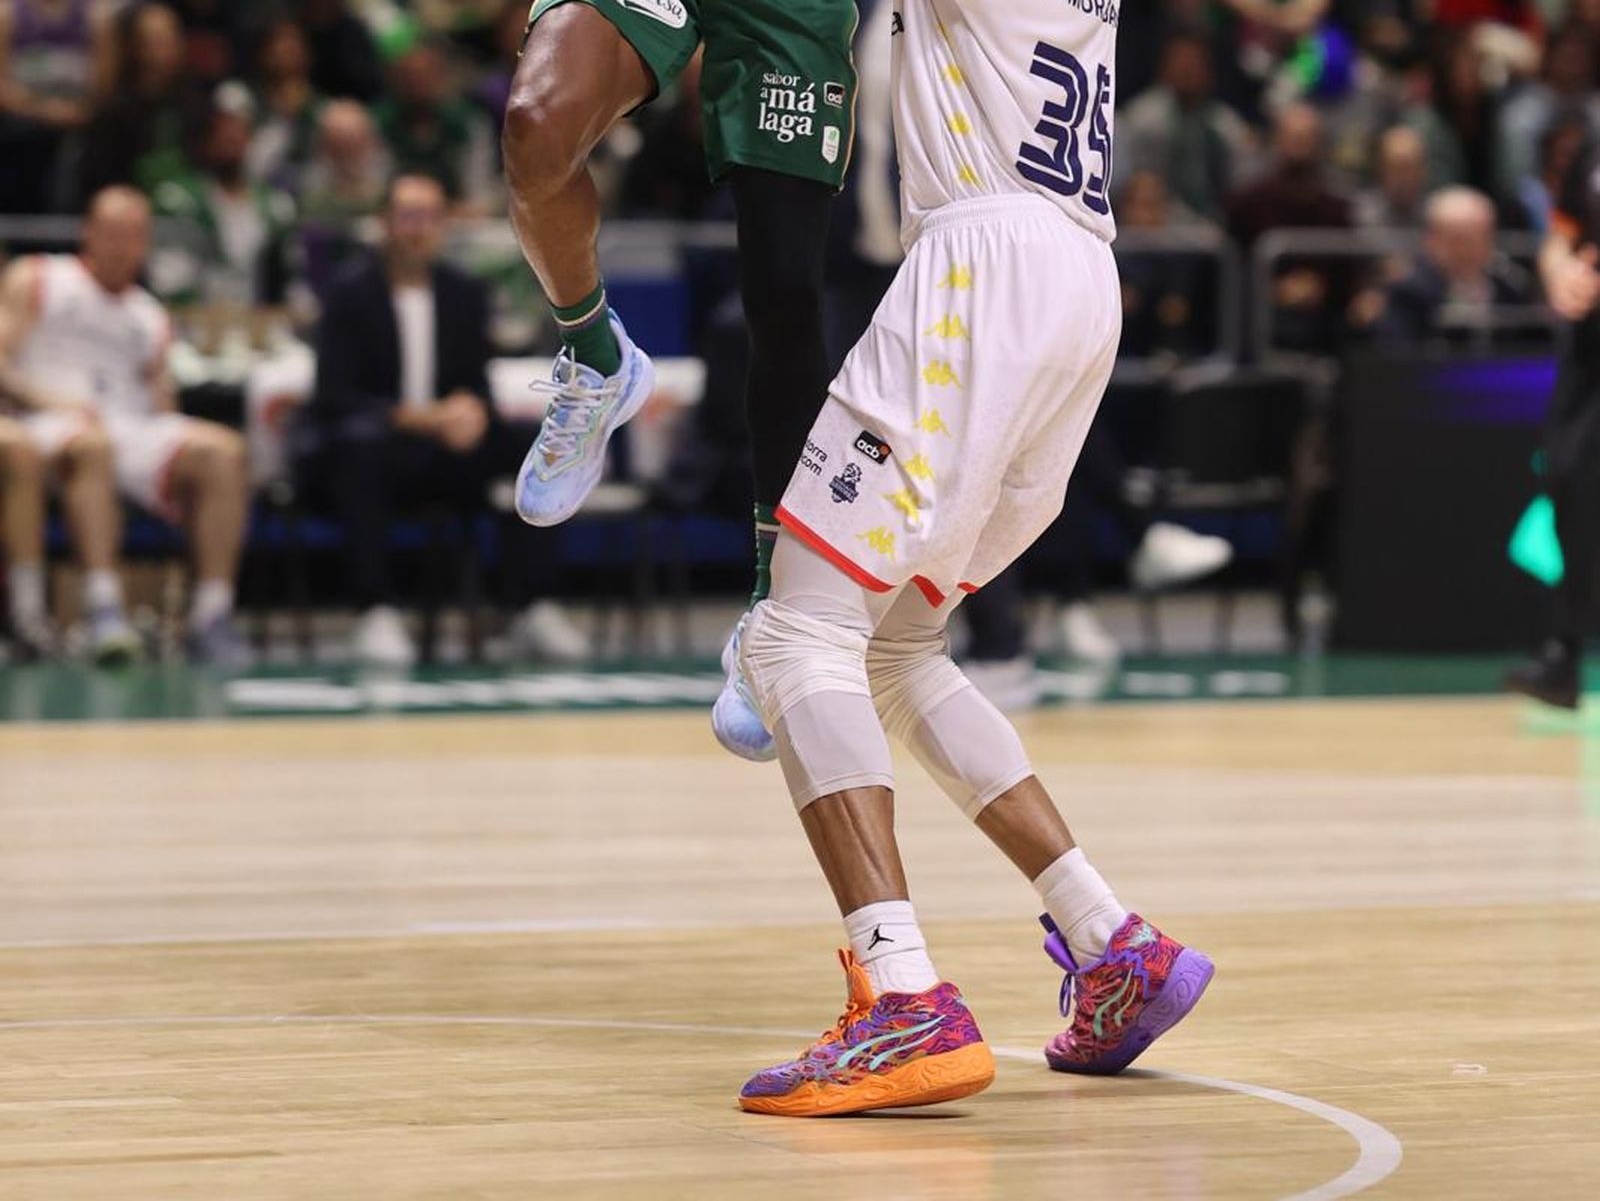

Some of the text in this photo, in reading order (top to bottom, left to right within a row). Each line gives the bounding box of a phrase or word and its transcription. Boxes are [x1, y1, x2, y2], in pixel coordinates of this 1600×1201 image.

[762, 69, 801, 87] sabor
[760, 82, 817, 114] a má
[758, 102, 815, 143] laga
[1015, 40, 1111, 215] 35
[856, 439, 880, 459] acb
